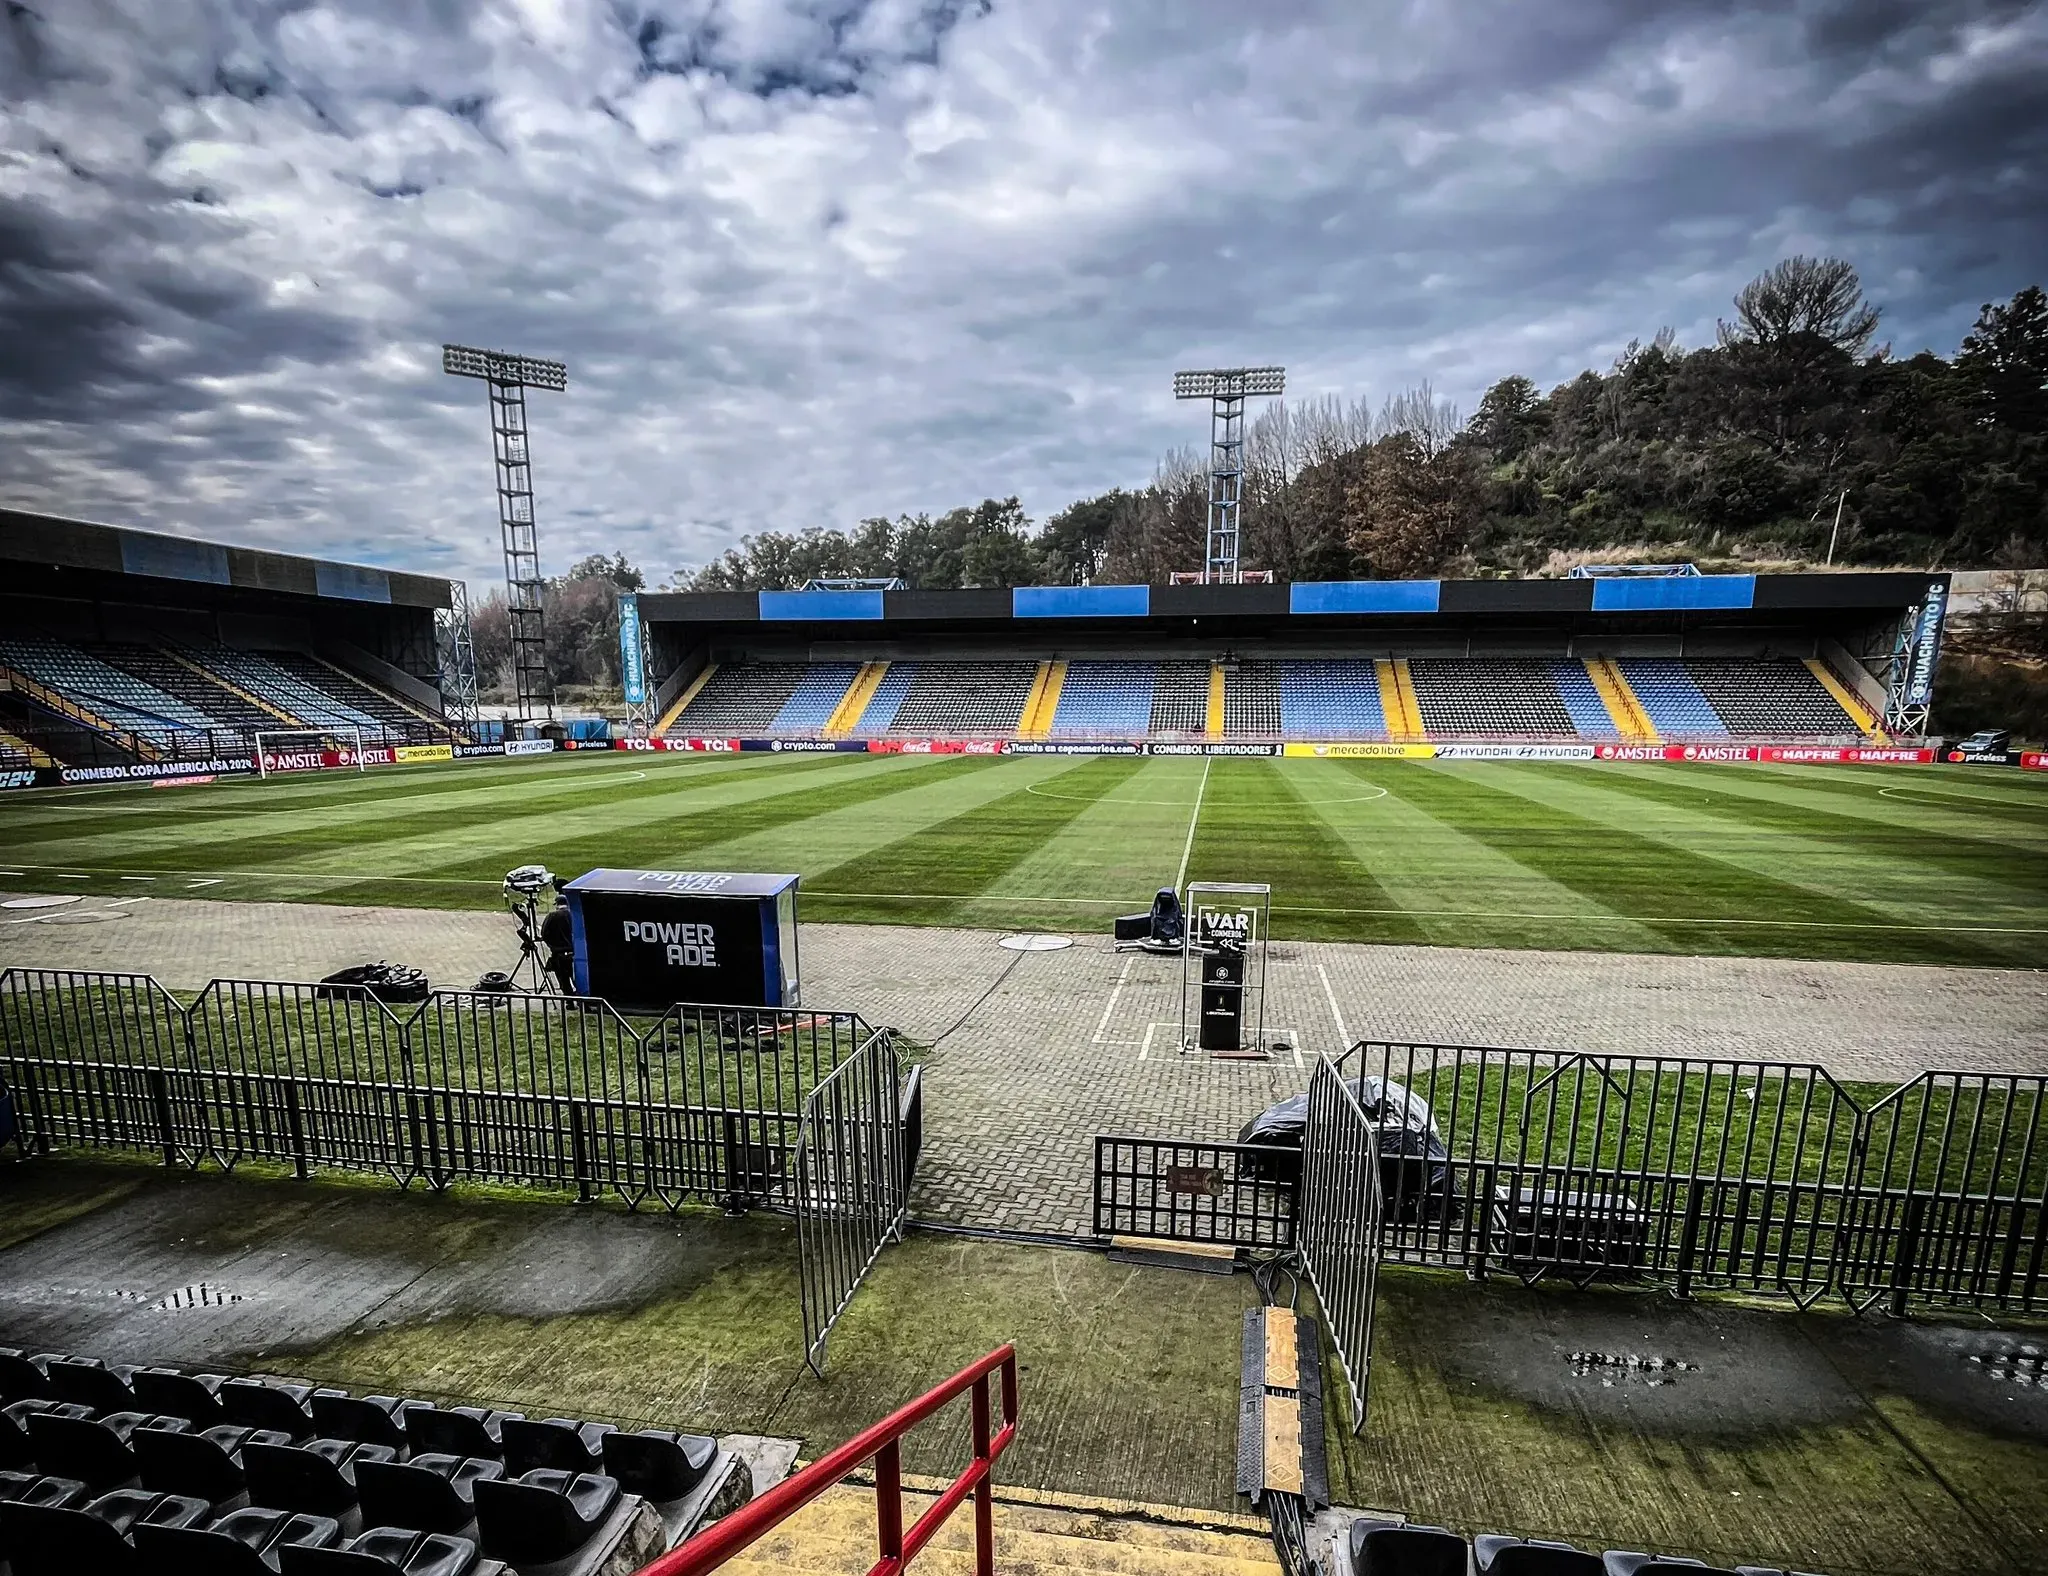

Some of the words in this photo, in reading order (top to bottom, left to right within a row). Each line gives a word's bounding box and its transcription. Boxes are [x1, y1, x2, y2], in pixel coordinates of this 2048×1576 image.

[624, 603, 634, 618] FC
[1914, 604, 1941, 685] HUACHIPATO
[1928, 584, 1945, 603] FC
[625, 619, 639, 685] HUACHIPATO
[463, 744, 504, 755] crypto.com
[521, 742, 552, 750] HYUNDAI
[578, 741, 607, 749] priceless
[624, 738, 655, 750] TCL
[663, 739, 693, 750] TCL
[702, 739, 733, 751] TCL
[783, 738, 836, 751] crypto.com
[902, 741, 933, 753] Coca-Cola
[965, 741, 995, 754] Coca-Cola
[1011, 742, 1043, 753] Tickets
[1045, 745, 1056, 753] en
[1153, 744, 1203, 755] CONMEBOL
[1205, 744, 1273, 755] LIBERTADORES
[1331, 744, 1379, 755] mercado
[1381, 745, 1405, 755] libre
[408, 748, 436, 757] mercado
[437, 747, 451, 756] libre
[1461, 747, 1511, 757] HYUNDAI
[1540, 748, 1592, 757] HYUNDAI
[1614, 748, 1666, 760] AMSTEL
[1697, 748, 1750, 760] AMSTEL
[1783, 750, 1841, 760] MAPFRE
[1860, 751, 1918, 761] MAPFRE
[1965, 752, 2007, 762] priceless
[277, 752, 325, 769] AMSTEL
[350, 749, 391, 765] AMSTEL
[62, 765, 130, 782] CONMEBOL
[130, 763, 162, 778] COPA
[162, 760, 209, 775] AMERICA
[209, 759, 229, 772] USA
[637, 872, 734, 884] POWER
[1205, 912, 1249, 930] VAR
[623, 920, 715, 945] POWER
[1211, 929, 1243, 938] CONMEBOL
